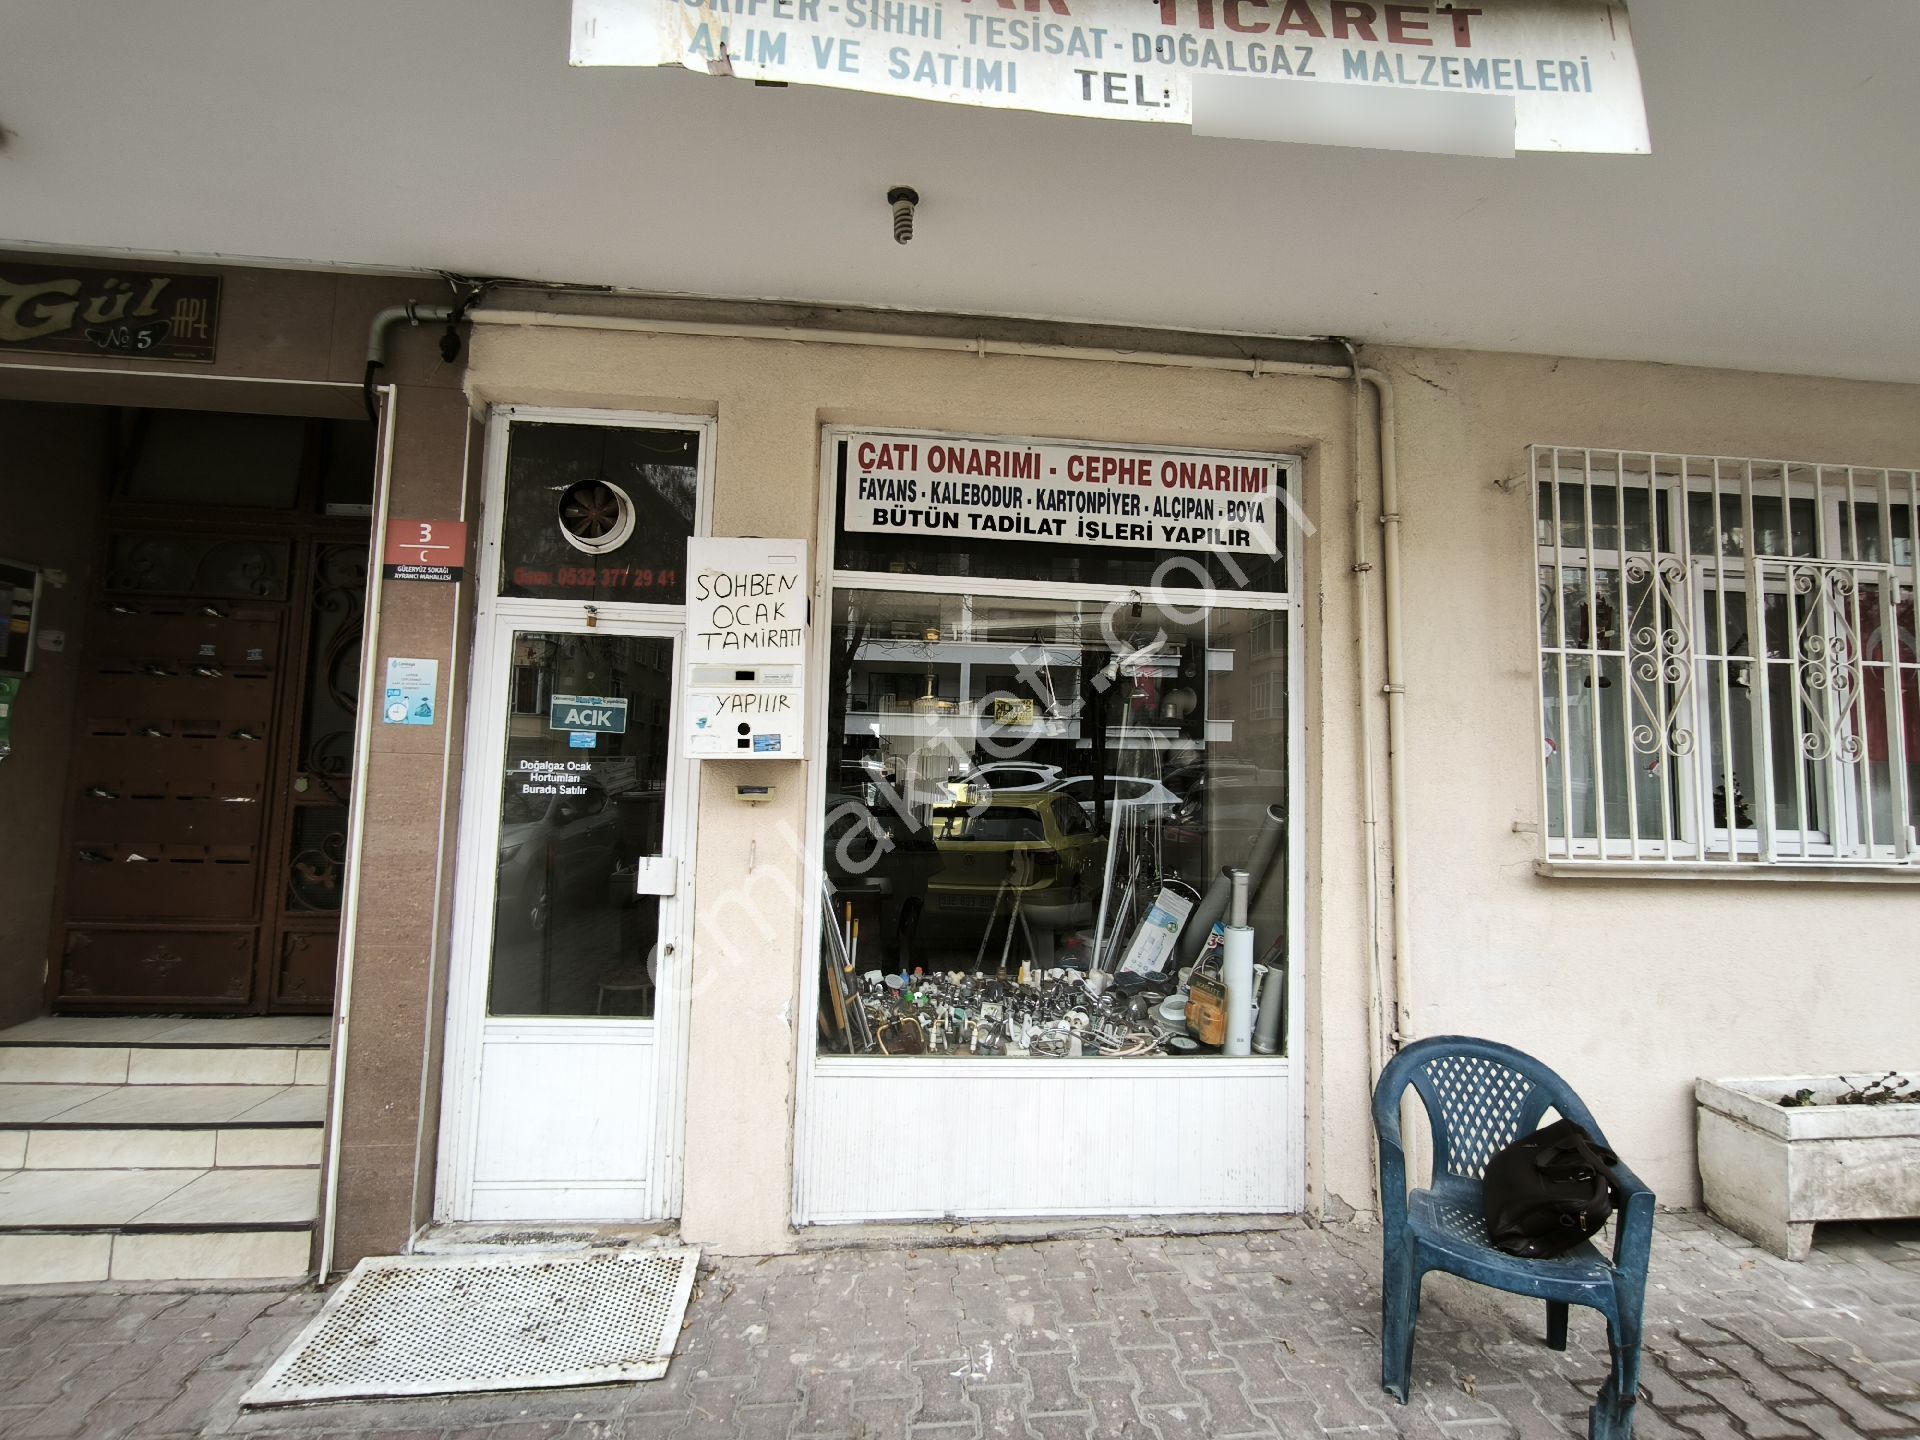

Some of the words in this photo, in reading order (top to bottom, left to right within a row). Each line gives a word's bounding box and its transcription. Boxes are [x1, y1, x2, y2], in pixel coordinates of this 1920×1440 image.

[811, 35, 861, 74] VE
[887, 46, 1017, 94] SATIMI
[1342, 47, 1593, 93] MALZEMELERİ
[0, 277, 171, 342] Gül
[137, 330, 152, 349] 5
[858, 441, 918, 474] ÇATI
[1067, 454, 1152, 487] CEPHE
[1160, 460, 1269, 493] ONARIMI
[858, 477, 917, 503] FAYANS
[930, 480, 1023, 509] KALEBODUR
[1036, 487, 1140, 517] KARTONPİYER
[1153, 495, 1214, 522] ALÇIPAN
[1227, 500, 1265, 524] BOYA
[419, 523, 432, 543] 3
[872, 504, 960, 530] BÜTÜN
[967, 511, 1067, 537] TADİLAT
[1077, 515, 1153, 541] İŞLERİ
[1161, 525, 1251, 547] YAPILIR
[420, 550, 429, 562] C
[634, 569, 654, 588] 29
[712, 602, 786, 629] OCAK
[564, 708, 613, 727] AÇIK
[520, 759, 565, 773] Doğalgaz
[567, 761, 592, 771] Ocak
[530, 772, 581, 783] Hortumları
[522, 783, 557, 795] Burada
[559, 785, 588, 795] Satılır
